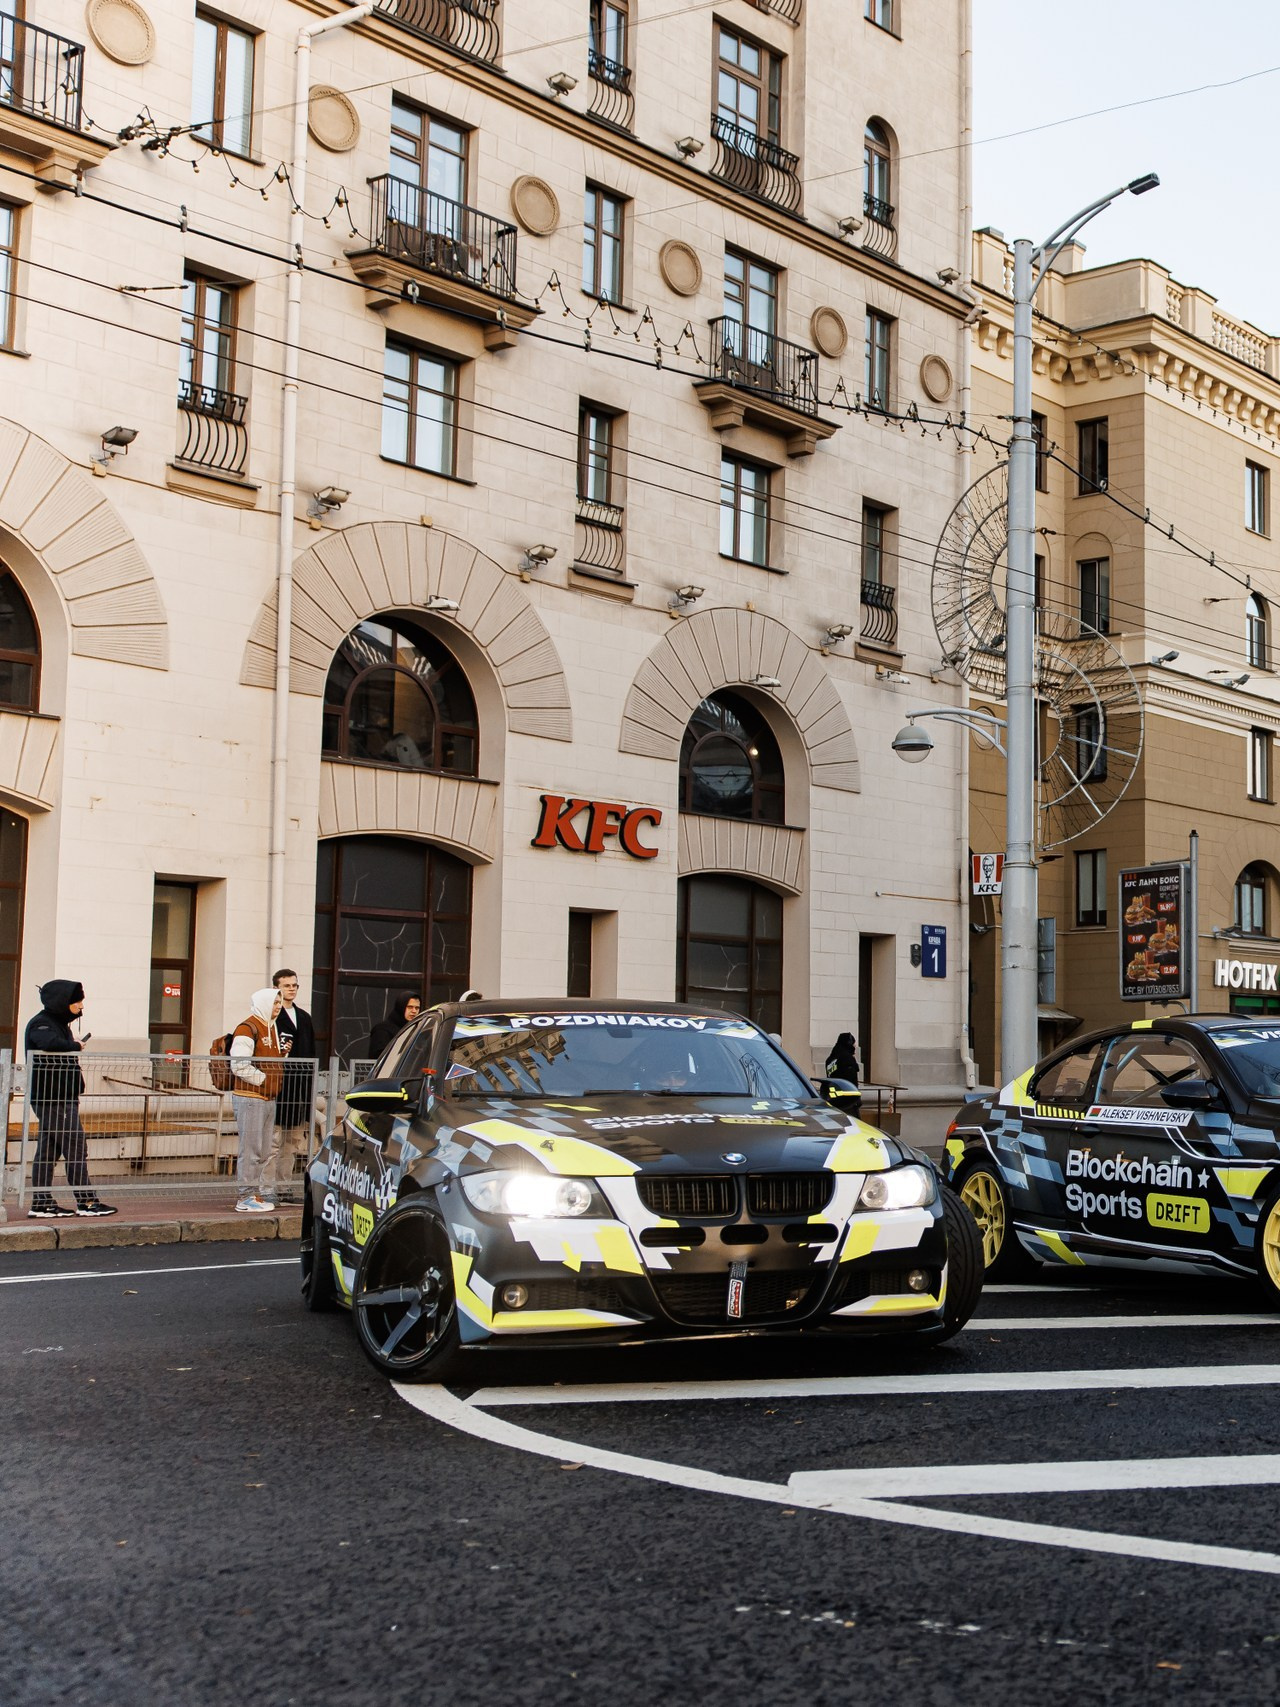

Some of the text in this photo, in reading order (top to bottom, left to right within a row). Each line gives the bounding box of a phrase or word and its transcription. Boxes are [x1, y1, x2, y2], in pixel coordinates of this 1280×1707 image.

[531, 795, 662, 859] KFC
[978, 884, 998, 893] KFC
[1138, 876, 1179, 887] ЛАНЧ БОКС
[931, 948, 938, 973] 1
[1215, 958, 1278, 991] HOTFIX
[509, 1015, 706, 1030] POZDNIAKOV
[584, 1113, 776, 1124] Blockchain
[591, 1118, 716, 1130] Sports
[1101, 1108, 1189, 1123] ALEKSEY VISHNEVSKY
[328, 1152, 371, 1200] Blockchain
[1066, 1149, 1193, 1189] Blockchain
[321, 1192, 353, 1235] Sports
[1065, 1183, 1201, 1225] Sports DRIFT
